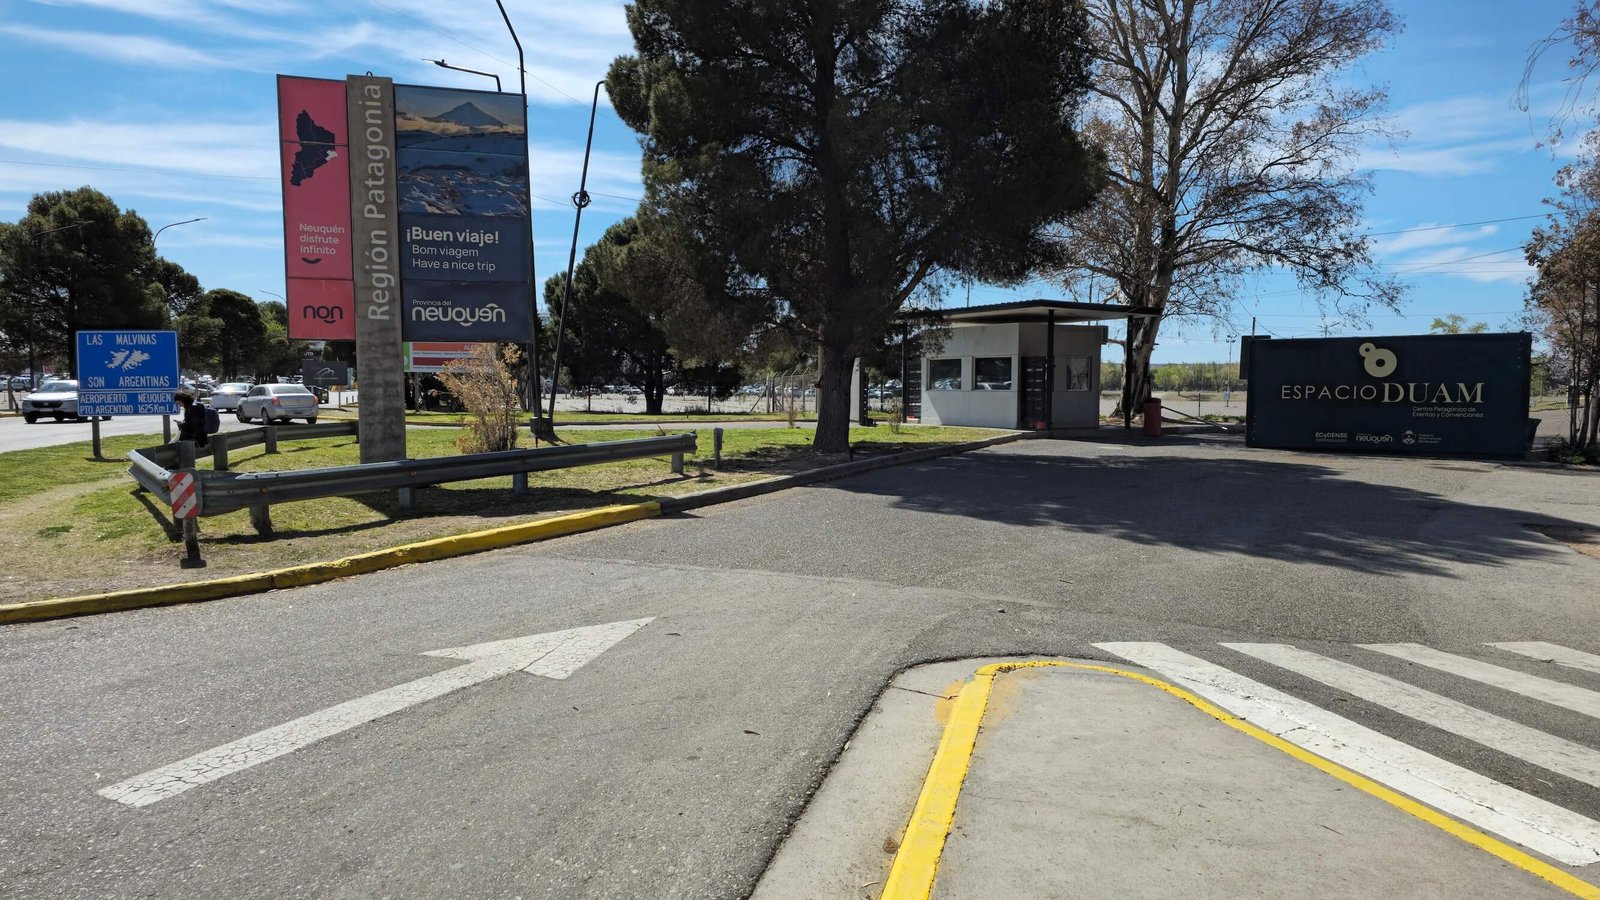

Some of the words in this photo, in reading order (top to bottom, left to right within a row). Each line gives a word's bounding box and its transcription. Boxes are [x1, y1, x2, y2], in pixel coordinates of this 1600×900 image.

[358, 84, 390, 219] Patagonia
[299, 223, 345, 234] Neuquén
[299, 233, 340, 245] disfrute
[406, 226, 454, 242] ¡Buen
[456, 229, 499, 247] viaje!
[300, 244, 337, 255] infinito
[412, 244, 437, 255] Bom
[439, 246, 479, 259] viagem
[412, 258, 441, 269] Have
[442, 261, 450, 269] a
[451, 261, 475, 270] nice
[476, 262, 496, 273] trip
[364, 229, 395, 321] Región
[87, 334, 102, 345] LAS
[116, 334, 156, 345] MALVINAS
[88, 376, 104, 387] SON
[119, 376, 169, 387] ARGENTINAS
[80, 394, 127, 403] AEROPUERTO
[138, 393, 171, 402] NEUQUEN
[1281, 385, 1377, 400] ESPACIO
[1381, 382, 1486, 404] DUAM
